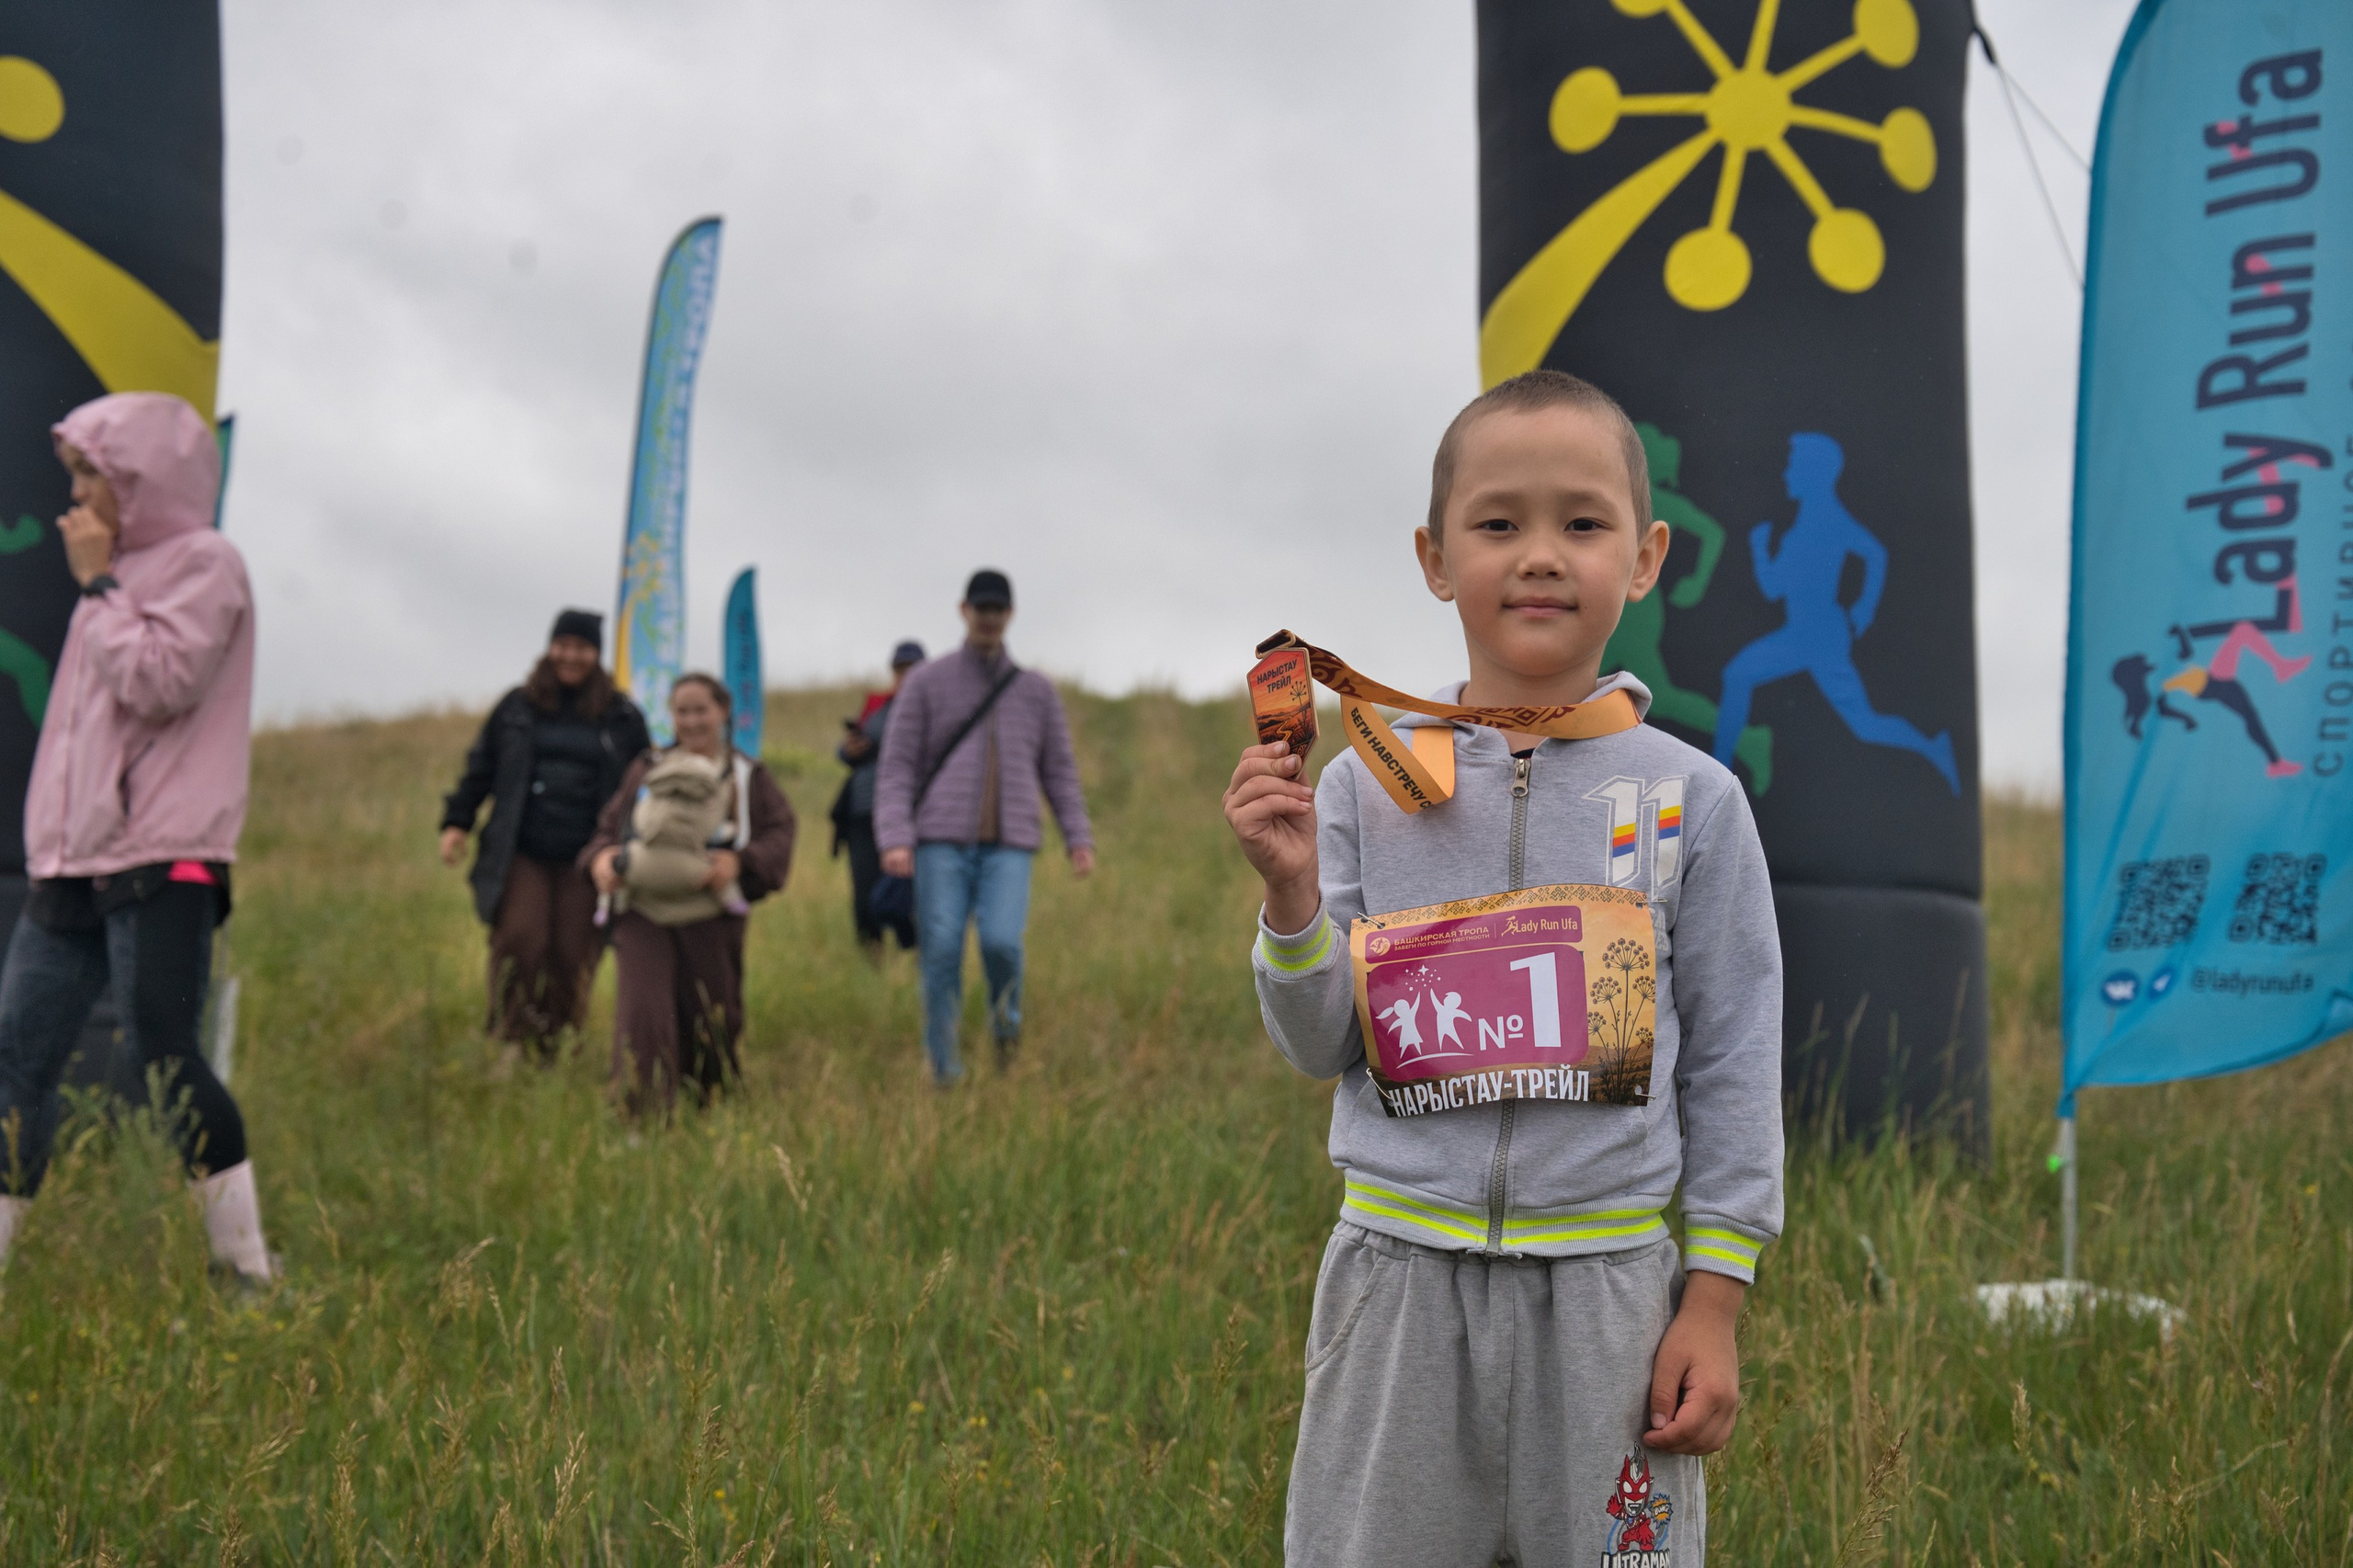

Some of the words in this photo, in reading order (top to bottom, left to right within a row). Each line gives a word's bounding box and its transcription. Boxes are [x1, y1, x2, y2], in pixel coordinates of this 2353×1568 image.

[2203, 47, 2323, 218] Ufa
[2195, 233, 2316, 409] Run
[2186, 432, 2334, 640] Lady
[1256, 658, 1298, 685] НАРЫСТАУ
[1267, 675, 1291, 694] ТРЕЙЛ
[1350, 707, 1373, 739] БЕГИ
[1367, 736, 1427, 801] НАВСТРЕЧУ
[1394, 930, 1457, 946] БАШКИРСКАЯ
[1459, 926, 1489, 937] ТРОПА
[1394, 943, 1416, 951] ЗАБЕГИ
[1427, 938, 1452, 947] ГОРНОЙ
[1452, 934, 1490, 943] МЕСТНОСТИ
[1516, 919, 1539, 934] Lady
[1540, 918, 1560, 930] Run
[1561, 917, 1578, 930] Ufa
[1388, 1063, 1590, 1118] НАРЫСТАУ-ТРЕЙЛ
